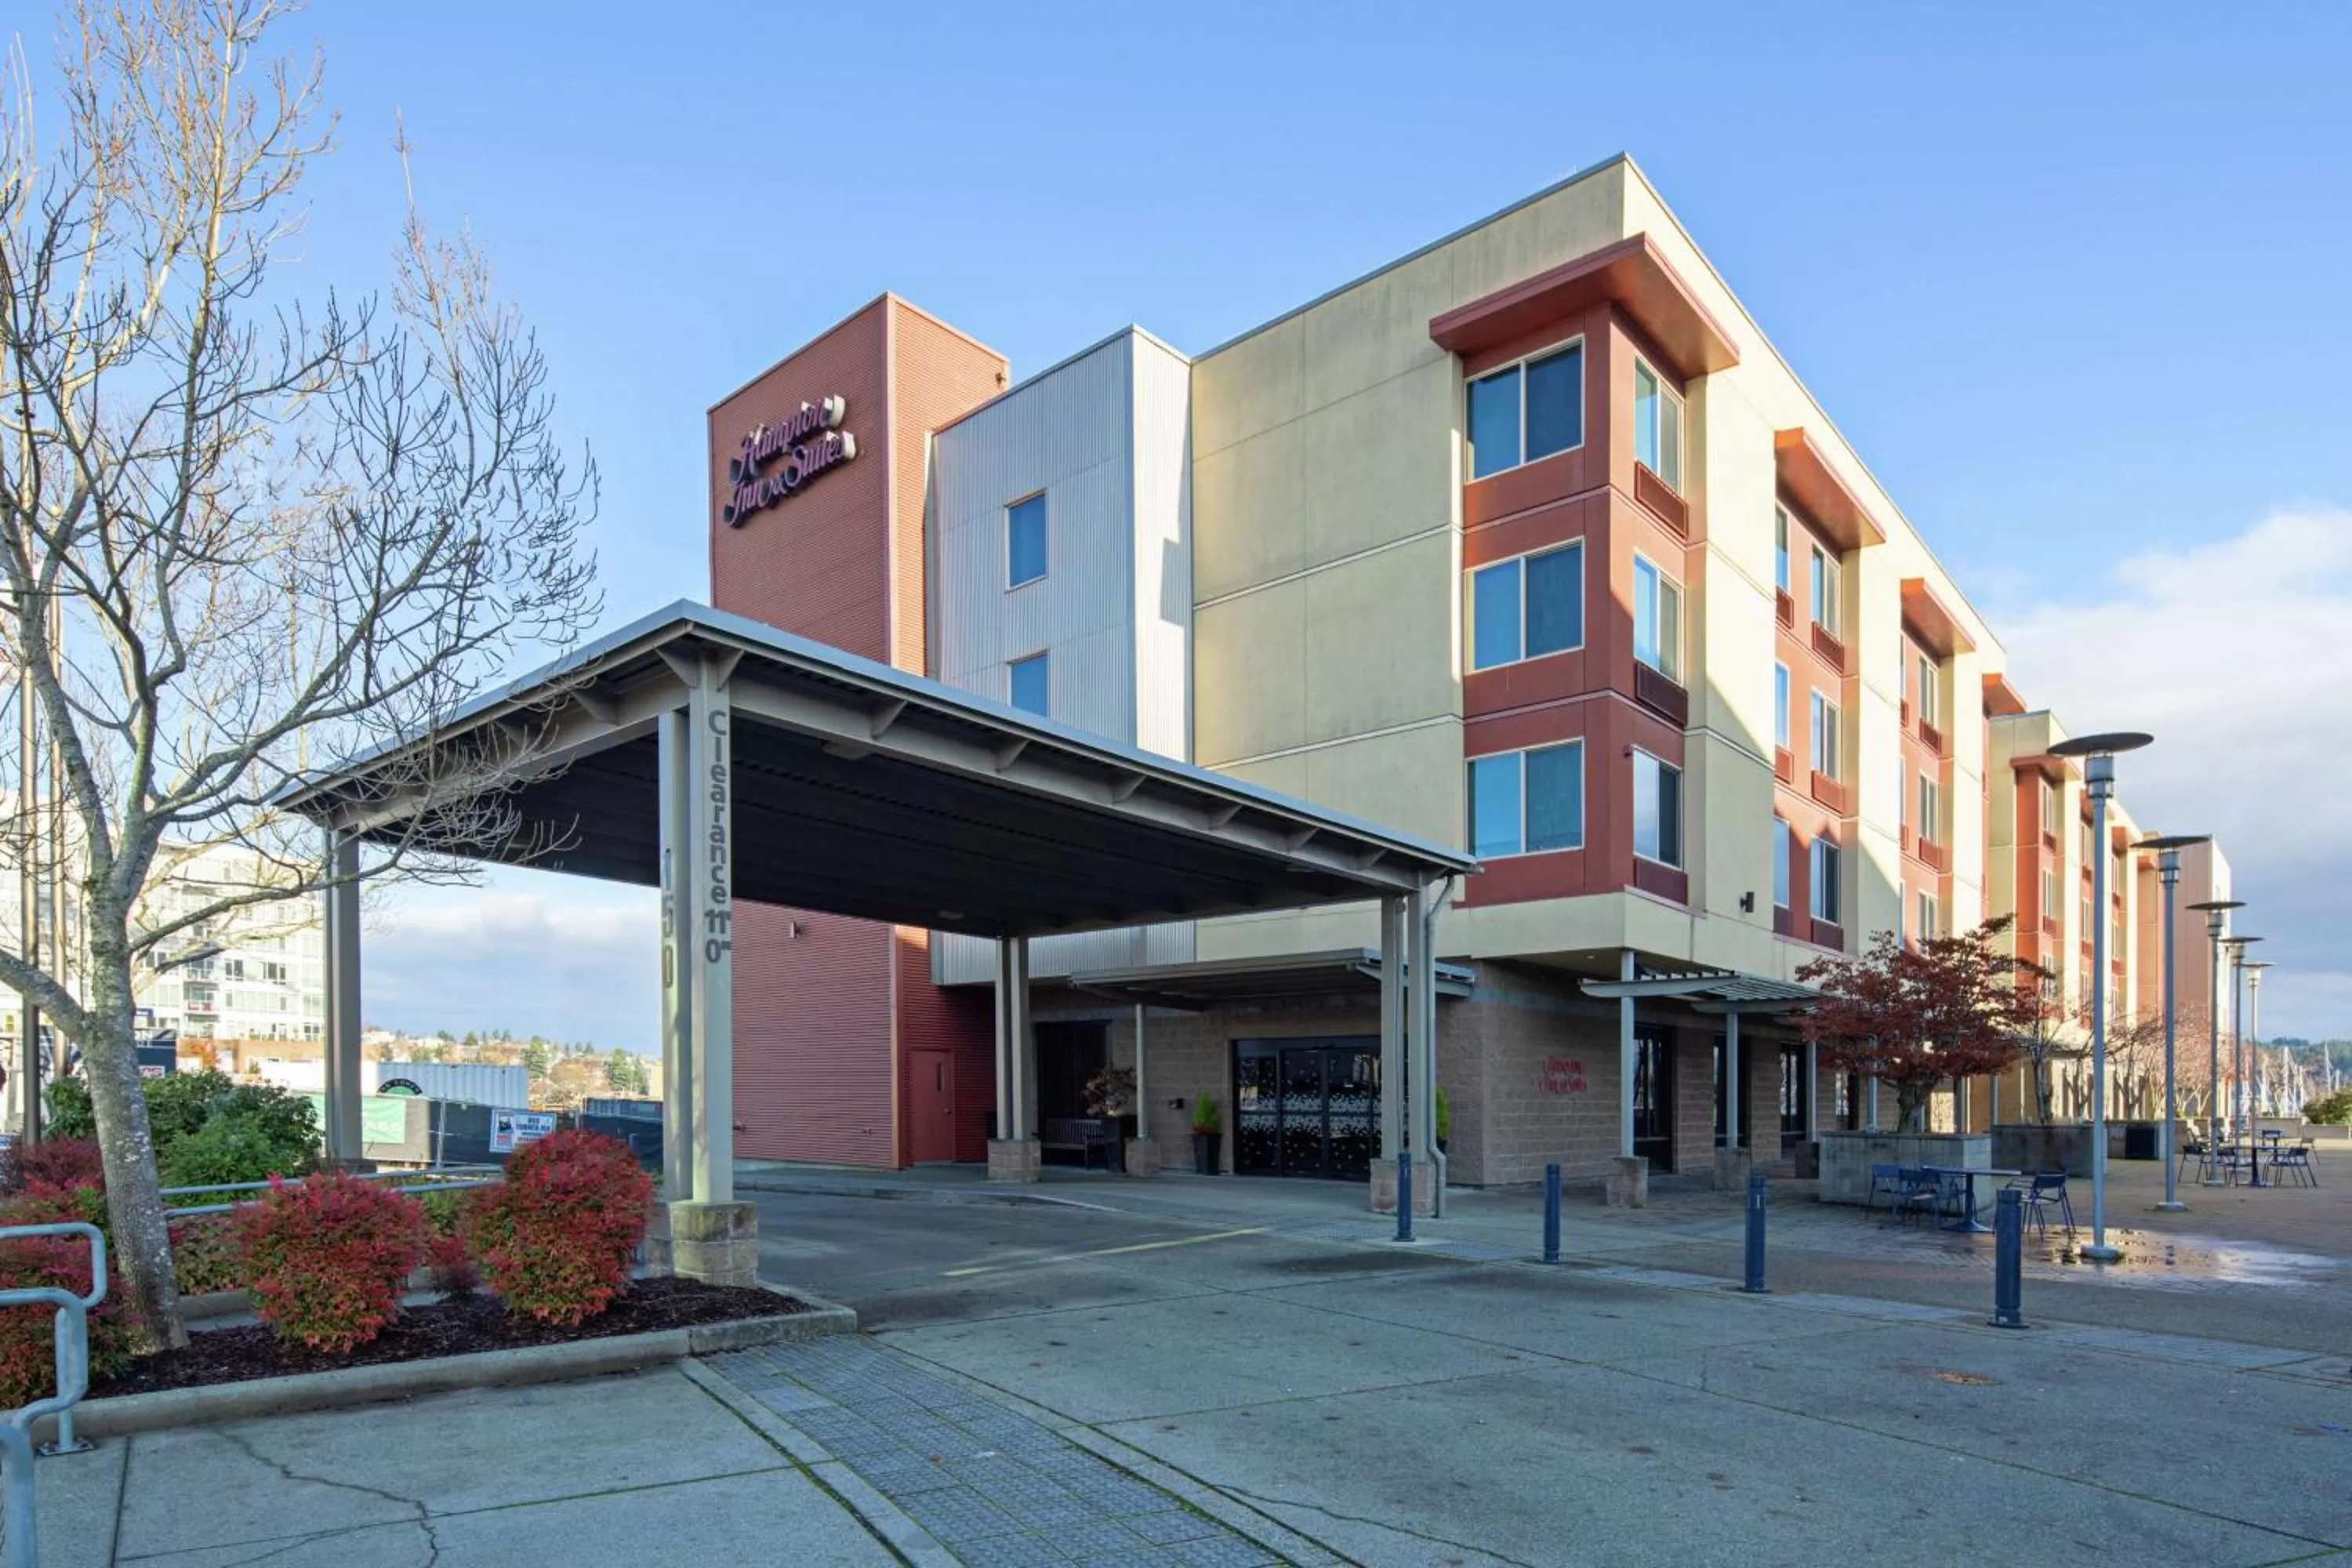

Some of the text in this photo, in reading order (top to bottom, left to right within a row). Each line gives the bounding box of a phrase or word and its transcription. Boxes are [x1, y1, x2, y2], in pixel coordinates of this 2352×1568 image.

[723, 480, 771, 528] Inn
[784, 430, 857, 488] Suites
[729, 394, 846, 485] Hampton
[708, 710, 728, 905] Clearance
